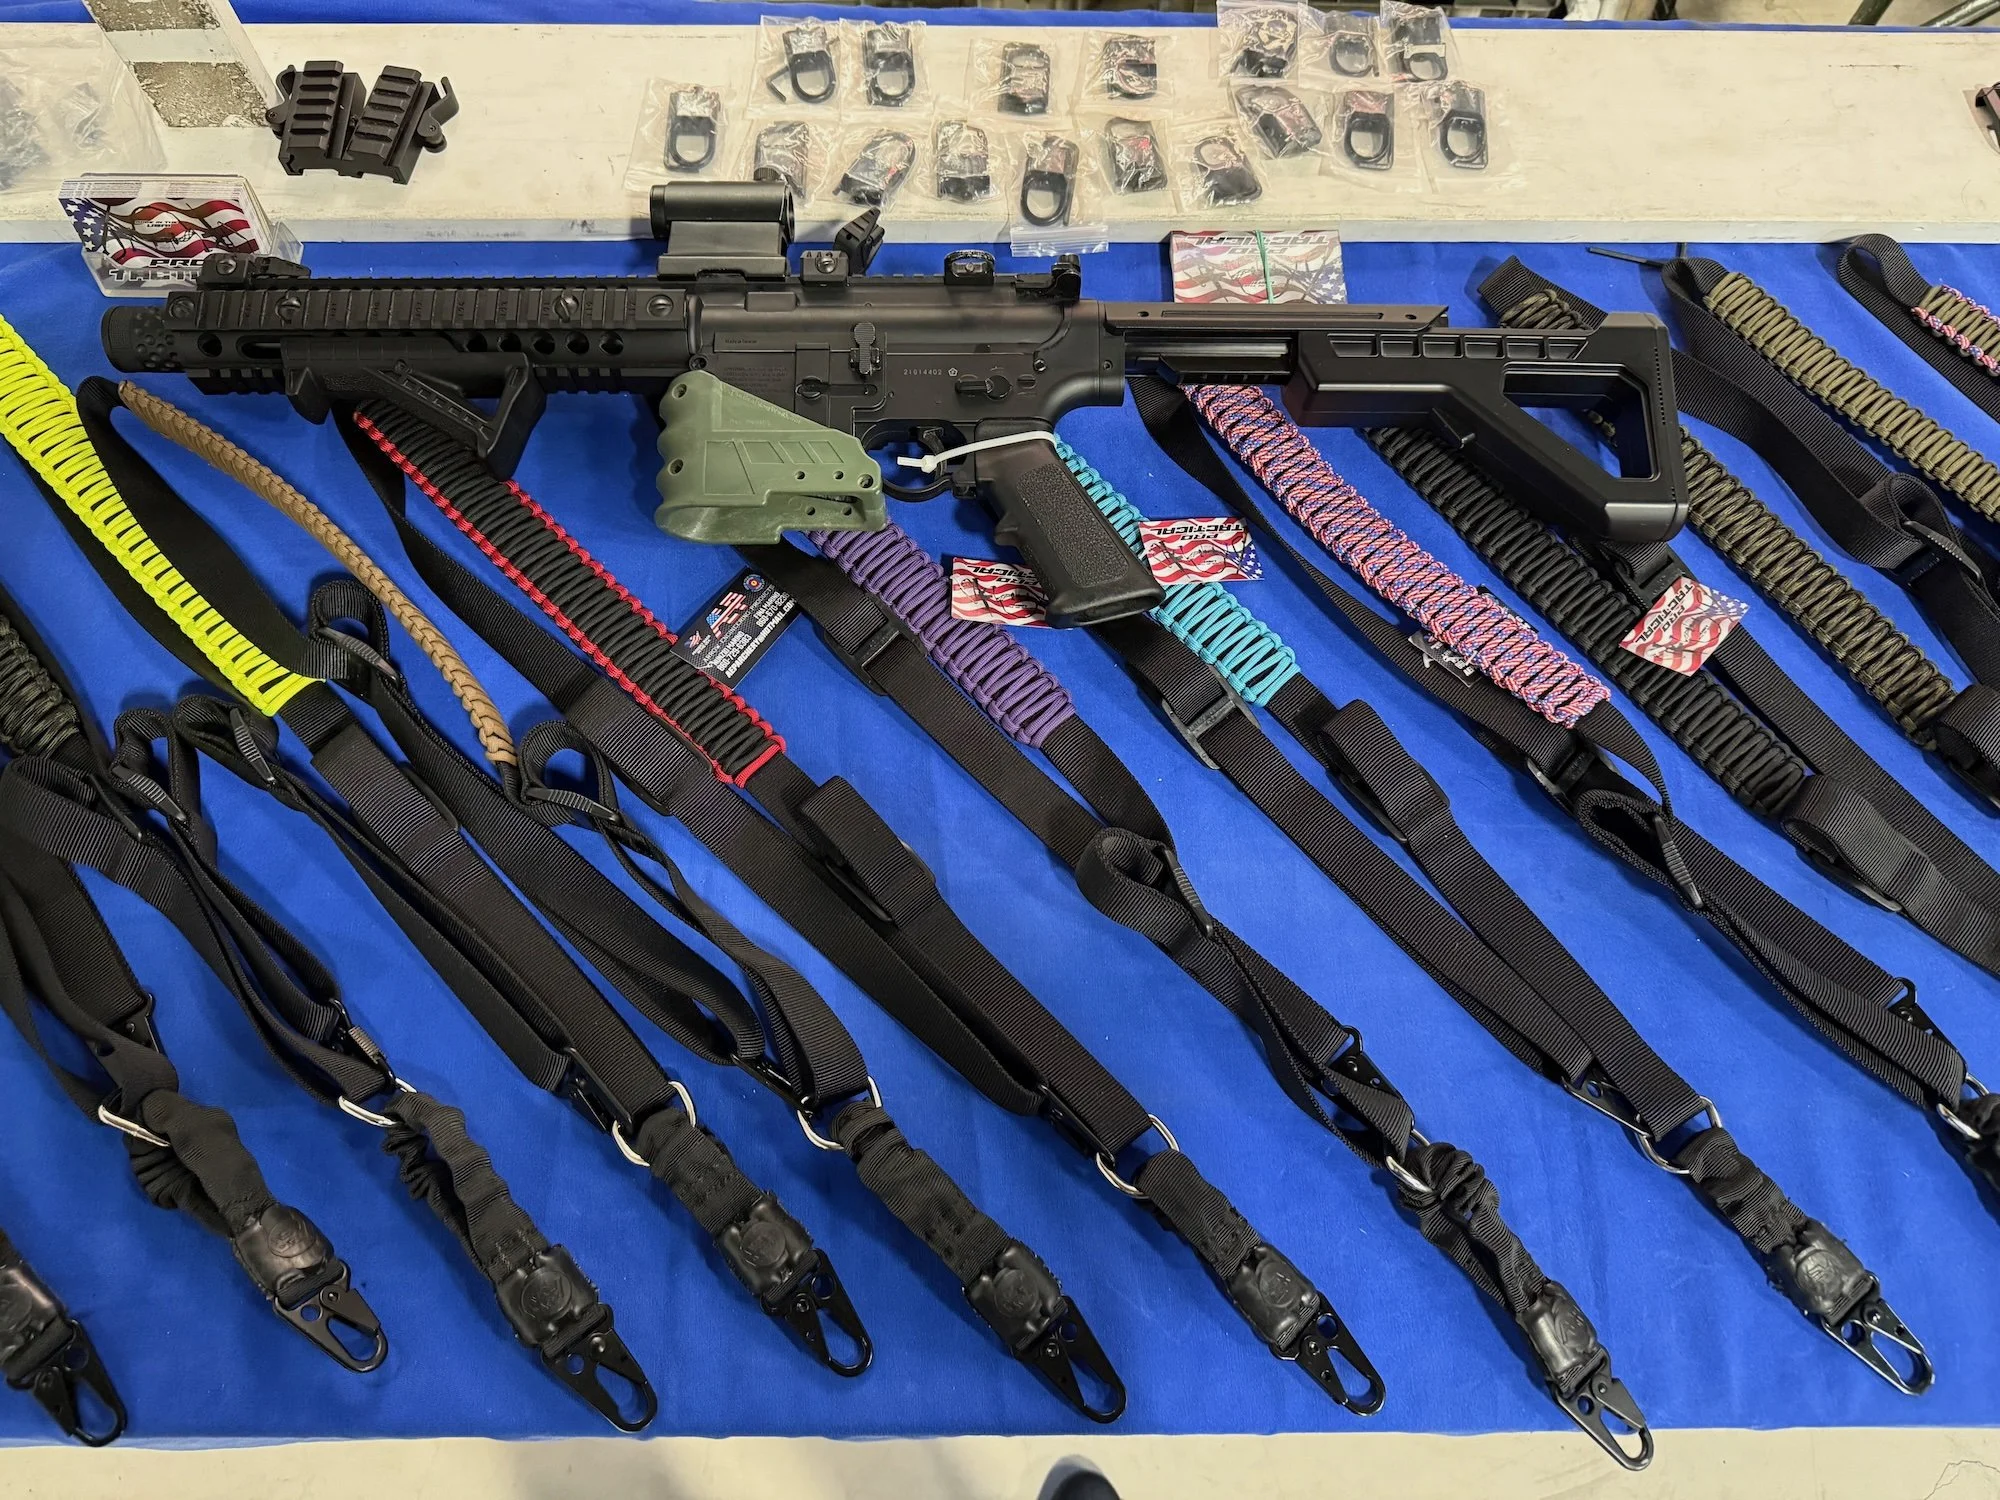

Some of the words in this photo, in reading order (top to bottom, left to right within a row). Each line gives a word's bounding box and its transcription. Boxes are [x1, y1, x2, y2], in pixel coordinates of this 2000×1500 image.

[1149, 524, 1243, 536] TACTICAL
[1180, 533, 1219, 541] PRO
[996, 577, 1040, 585] PRO
[1635, 583, 1694, 643] TACTICAL
[1661, 604, 1686, 633] PRO
